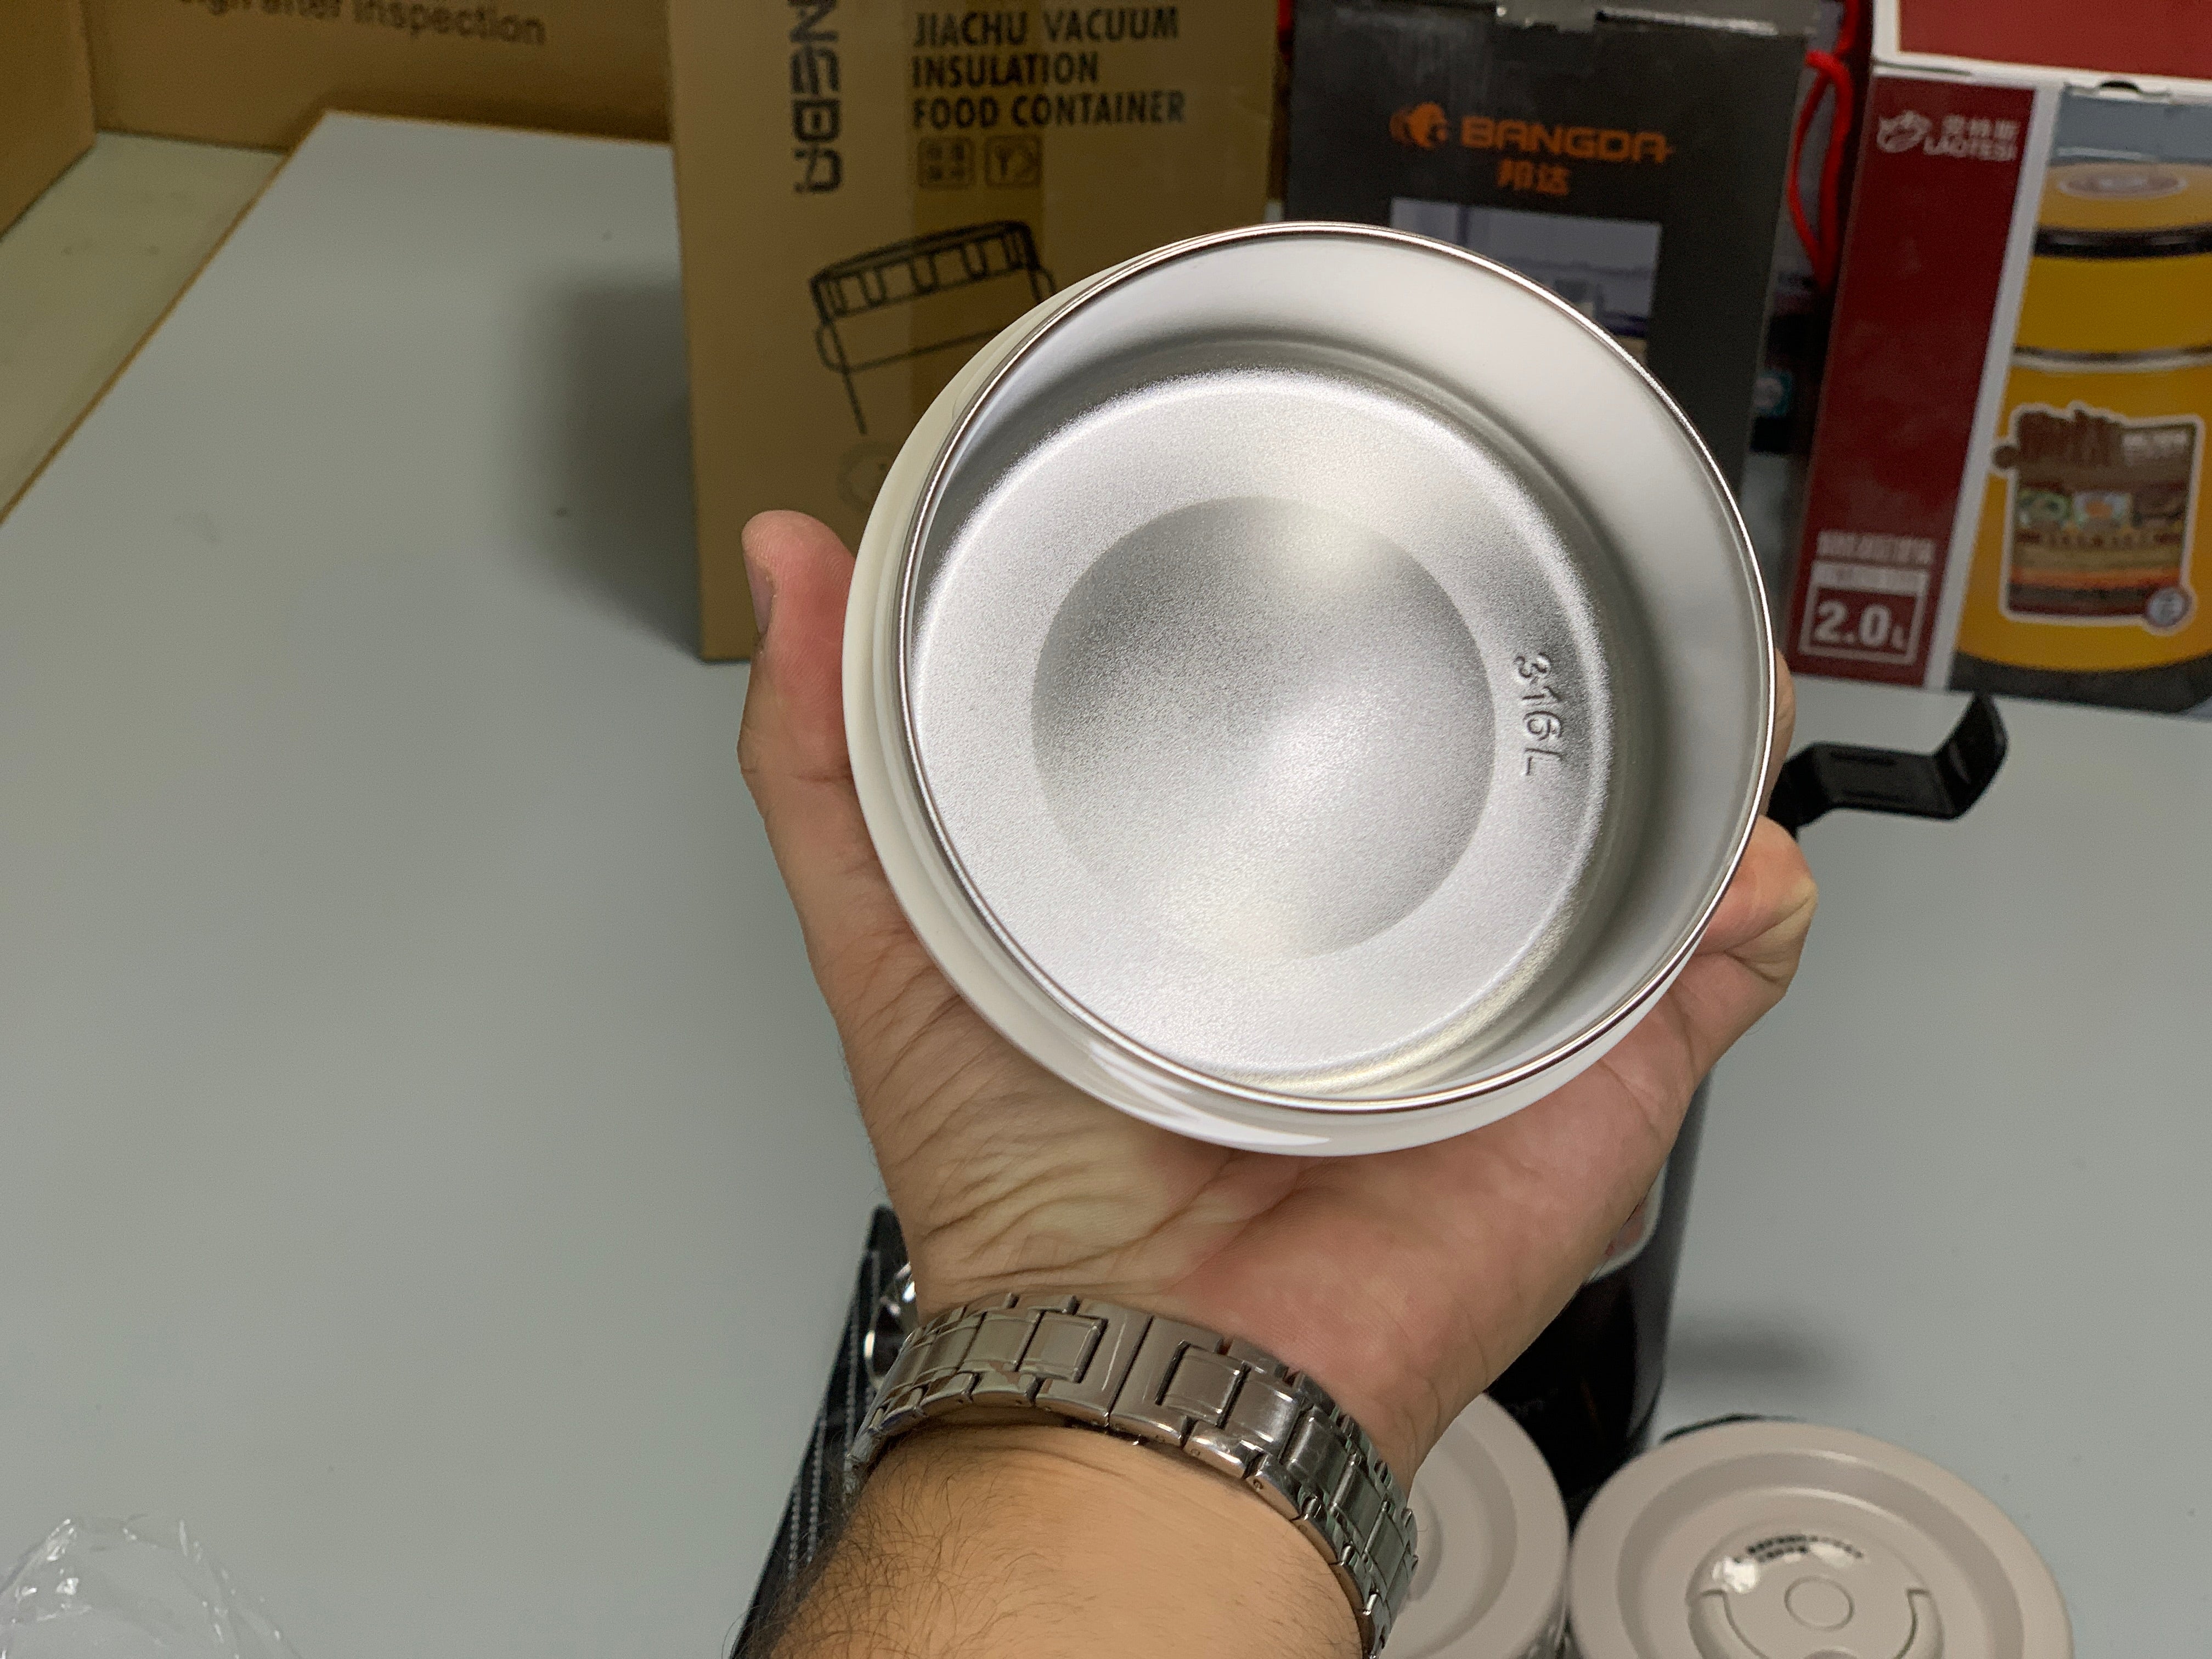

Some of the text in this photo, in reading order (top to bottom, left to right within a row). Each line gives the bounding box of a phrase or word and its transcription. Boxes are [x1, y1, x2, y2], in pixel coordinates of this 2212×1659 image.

[913, 5, 1180, 48] JIACHU VACUUM
[911, 50, 1099, 88] INSULATION
[911, 89, 1186, 131] FOOD CONTAINER
[1461, 116, 1668, 163] BANGDA
[1513, 652, 1564, 776] 316L
